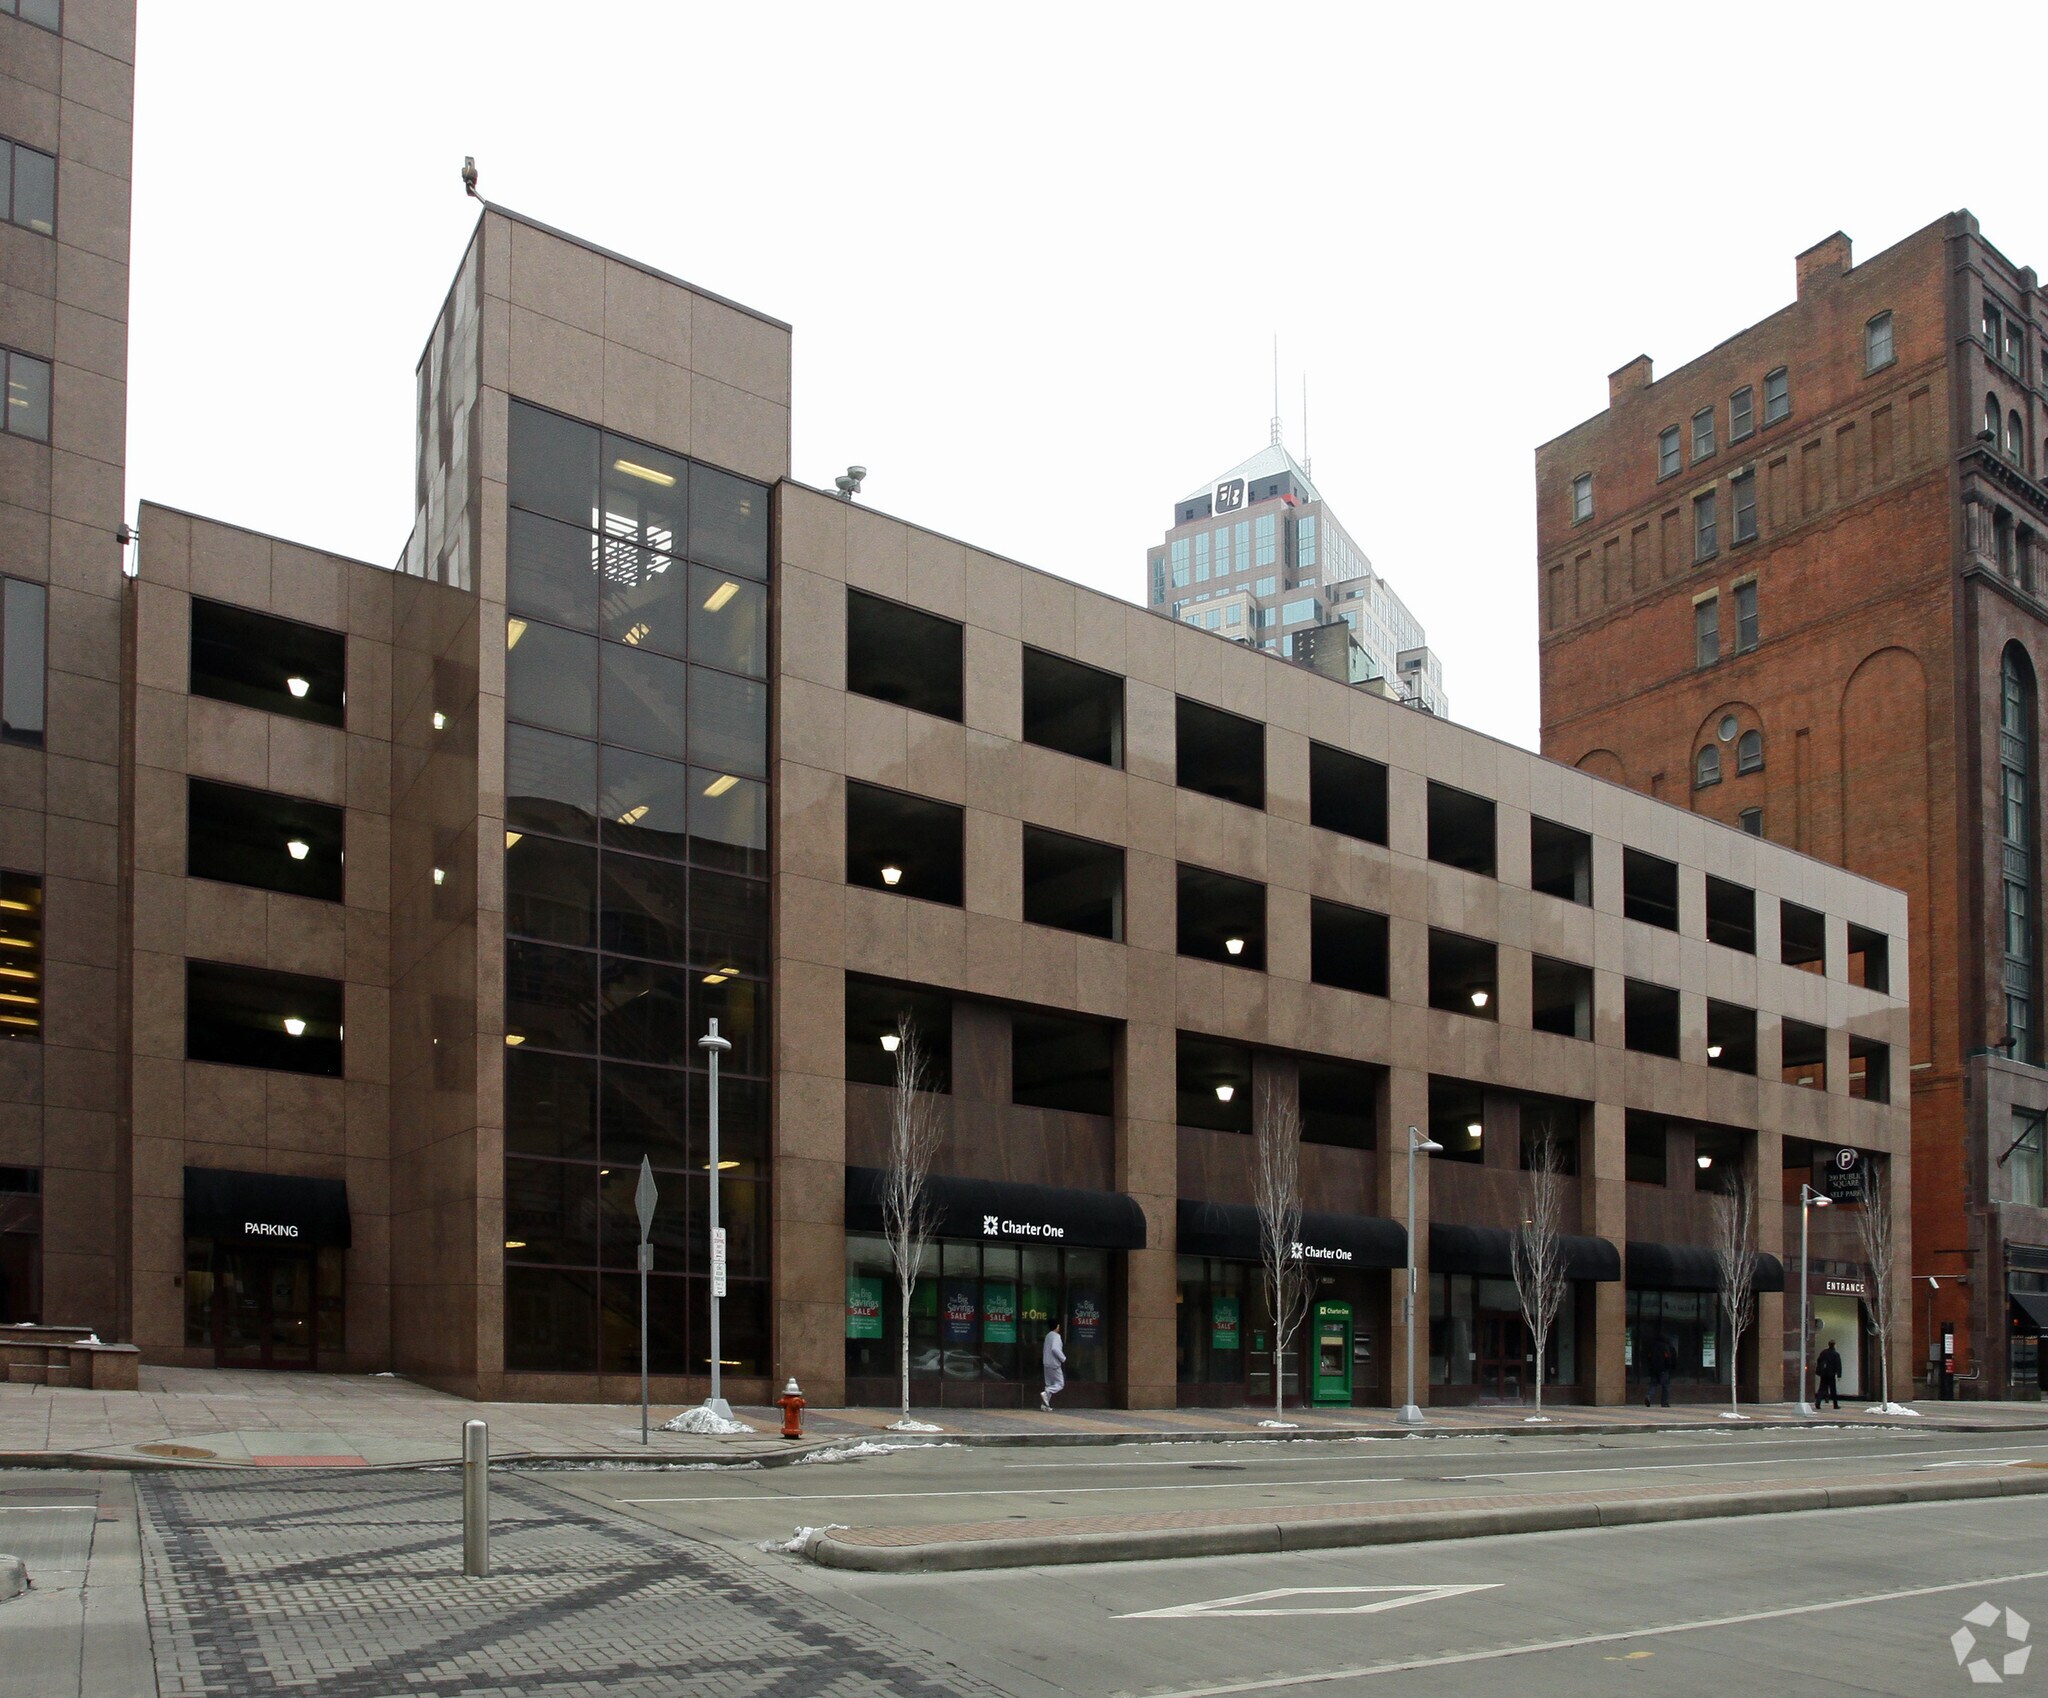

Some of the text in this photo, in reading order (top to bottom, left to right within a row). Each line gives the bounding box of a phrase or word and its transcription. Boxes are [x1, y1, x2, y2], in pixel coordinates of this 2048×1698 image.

[1841, 1152, 1851, 1167] P
[1832, 1179, 1860, 1189] SQUARE
[245, 1222, 298, 1237] PARKING
[1001, 1219, 1064, 1237] Charter One
[1305, 1245, 1353, 1261] Charter One
[1826, 1281, 1865, 1293] ENTRANCE
[860, 1287, 873, 1300] Big
[957, 1293, 969, 1306] Big
[849, 1297, 879, 1310] Savings
[996, 1295, 1008, 1307] Big
[1084, 1300, 1095, 1312] Big
[853, 1308, 871, 1316] SALE
[947, 1302, 975, 1315] Savings
[986, 1304, 1014, 1316] Savings
[1028, 1308, 1048, 1320] One
[1075, 1308, 1100, 1320] Savings
[950, 1312, 967, 1320] SALE
[990, 1314, 1006, 1322] SALE
[1078, 1317, 1093, 1326] SALE
[1217, 1322, 1231, 1330] SALE
